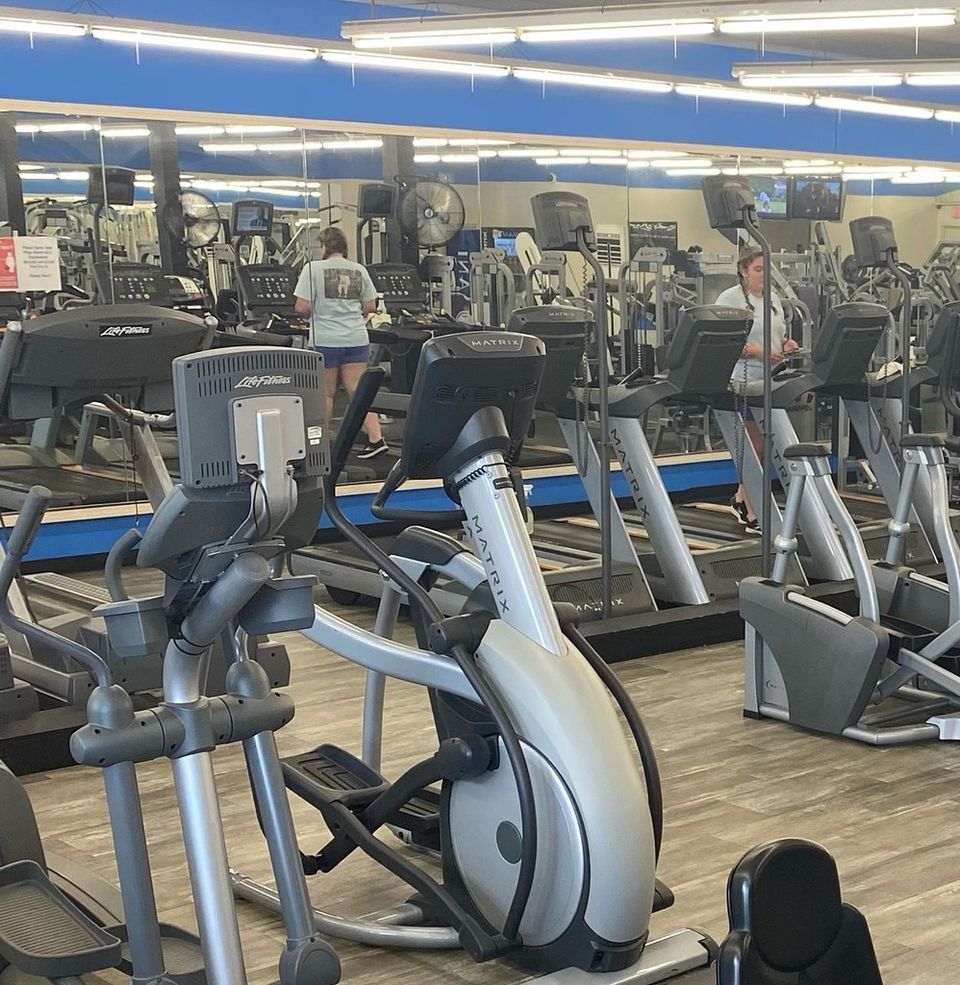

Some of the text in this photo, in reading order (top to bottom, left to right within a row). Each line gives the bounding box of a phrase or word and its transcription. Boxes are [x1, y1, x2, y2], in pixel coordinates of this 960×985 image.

[610, 428, 650, 519] MATRIX
[472, 515, 510, 614] MATRIX
[575, 598, 624, 611] MATIX
